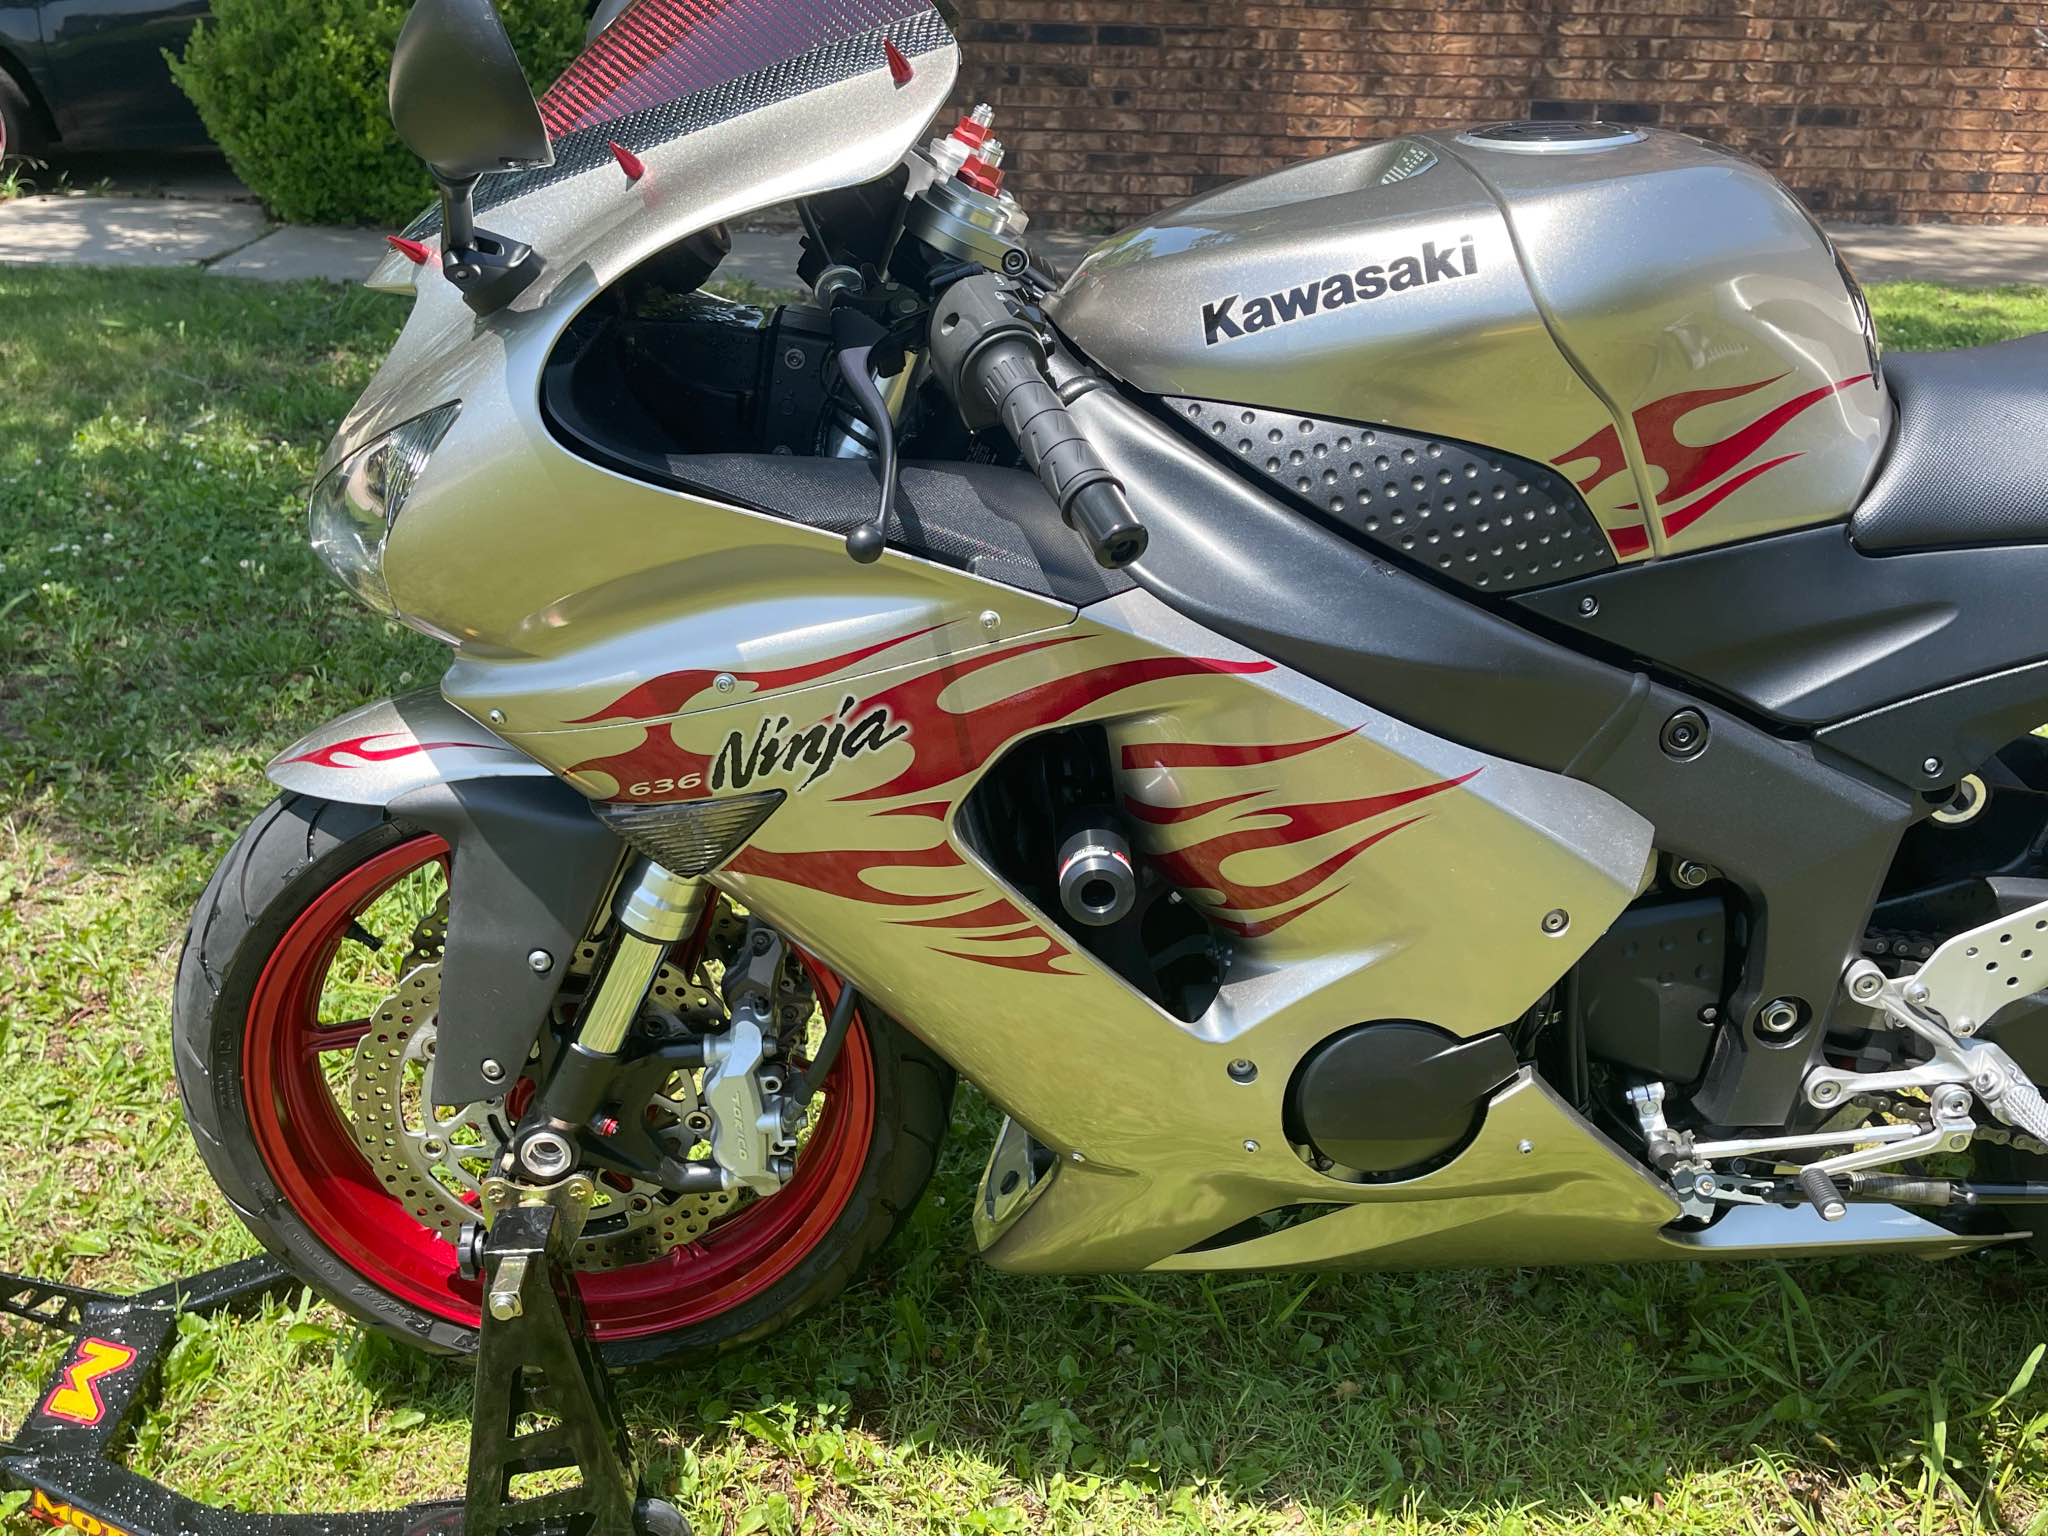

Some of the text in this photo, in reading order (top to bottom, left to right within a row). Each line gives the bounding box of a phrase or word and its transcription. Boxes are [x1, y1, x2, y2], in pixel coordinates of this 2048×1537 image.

[1201, 234, 1478, 346] Kawasaki
[628, 772, 702, 796] 636
[711, 696, 908, 792] Ninja
